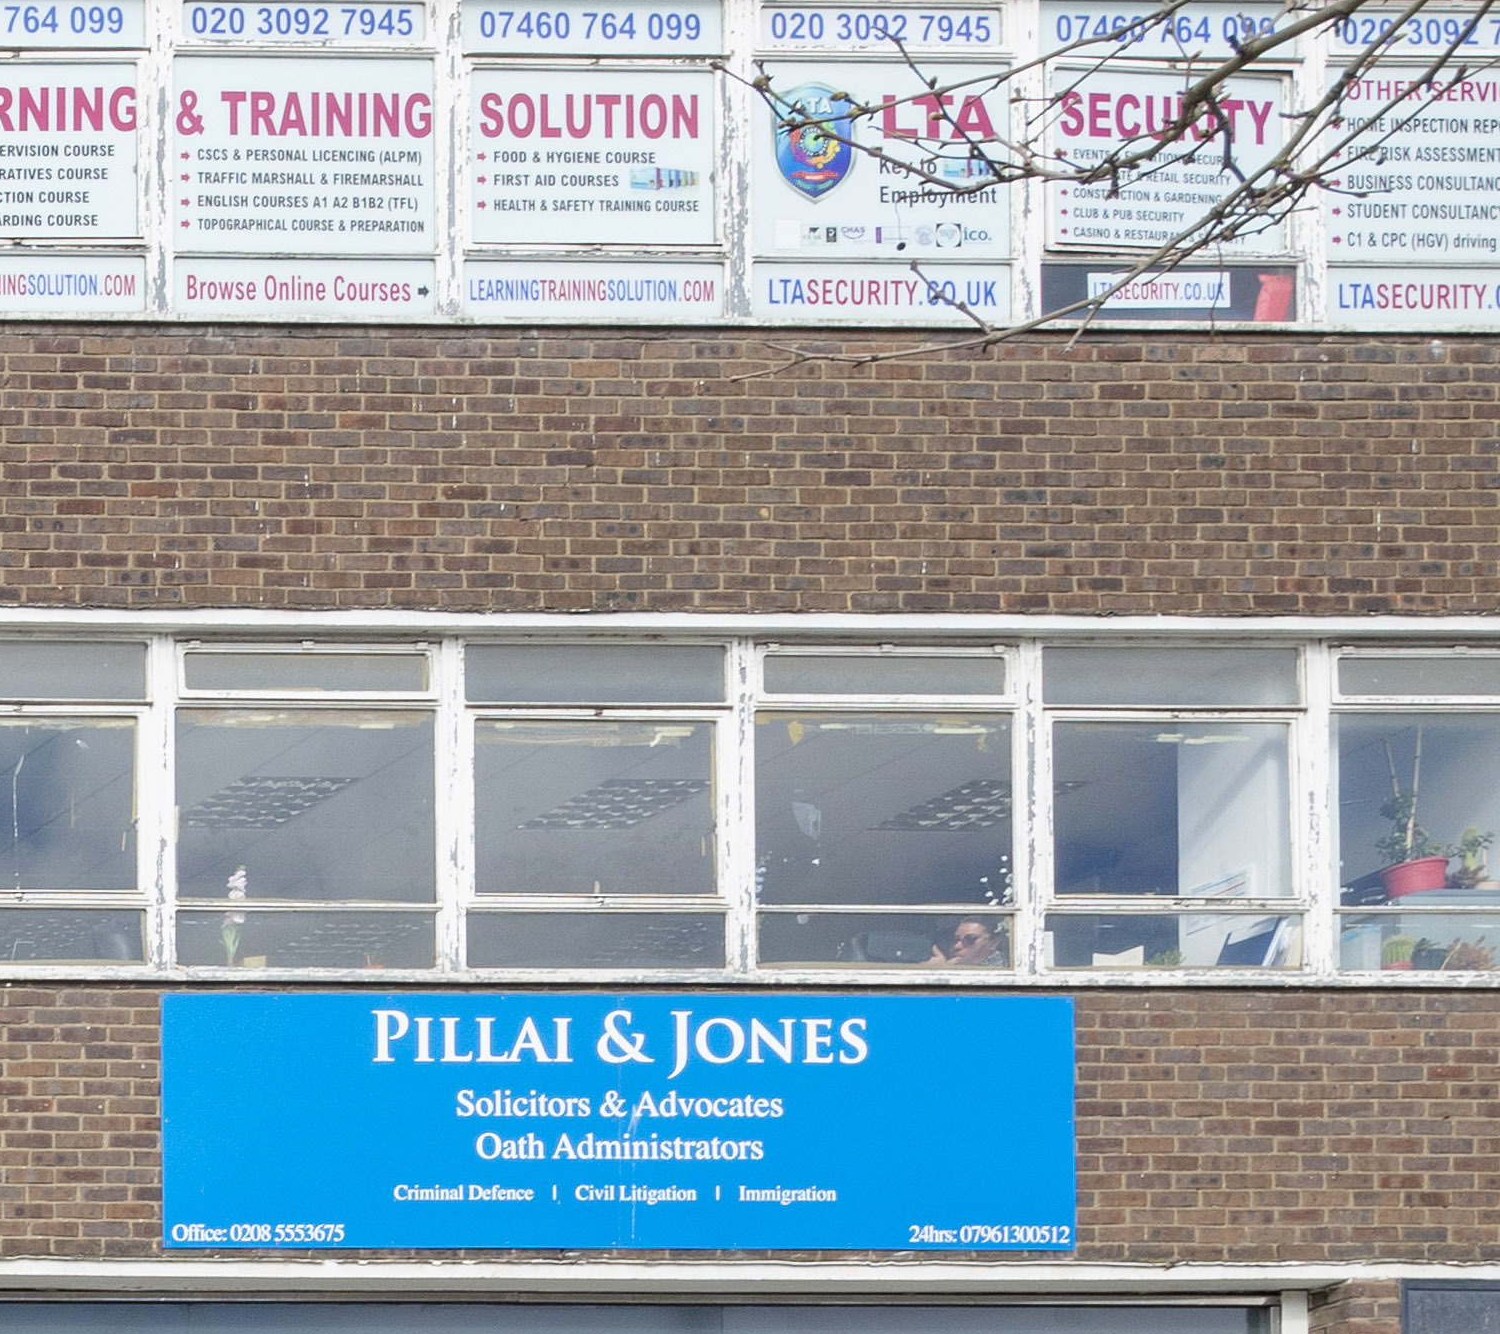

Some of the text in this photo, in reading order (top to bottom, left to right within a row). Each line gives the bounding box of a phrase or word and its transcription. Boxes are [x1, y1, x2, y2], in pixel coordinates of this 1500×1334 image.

[5, 6, 58, 33] 764
[71, 7, 122, 33] 099
[193, 7, 412, 35] 020 3092 7945
[481, 11, 700, 40] 07460 764 099
[176, 90, 431, 138] & TRAINING
[480, 93, 698, 139] SOLUTION
[882, 94, 996, 140] LTA
[64, 145, 114, 156] COURSE
[58, 168, 107, 179] COURSE
[39, 192, 89, 203] COURSE
[48, 215, 97, 226] COURSE
[187, 275, 410, 301] Browse Online Courses
[470, 280, 714, 301] LEARNINGTRAININGSOLUTION.COM
[768, 279, 997, 307] LTASECURITY.COUK
[372, 1010, 868, 1079] PILLAI & JONES
[456, 1090, 783, 1117] Solicitors & Advocates
[476, 1133, 764, 1160] Oath Administrators
[394, 1185, 533, 1200] Criminal Defence
[575, 1185, 696, 1205] Civil Litigation
[740, 1185, 836, 1205] Immigration
[172, 1224, 344, 1242] Office: 0208 5553675
[909, 1225, 1070, 1243] 24hrs: 07961300512
